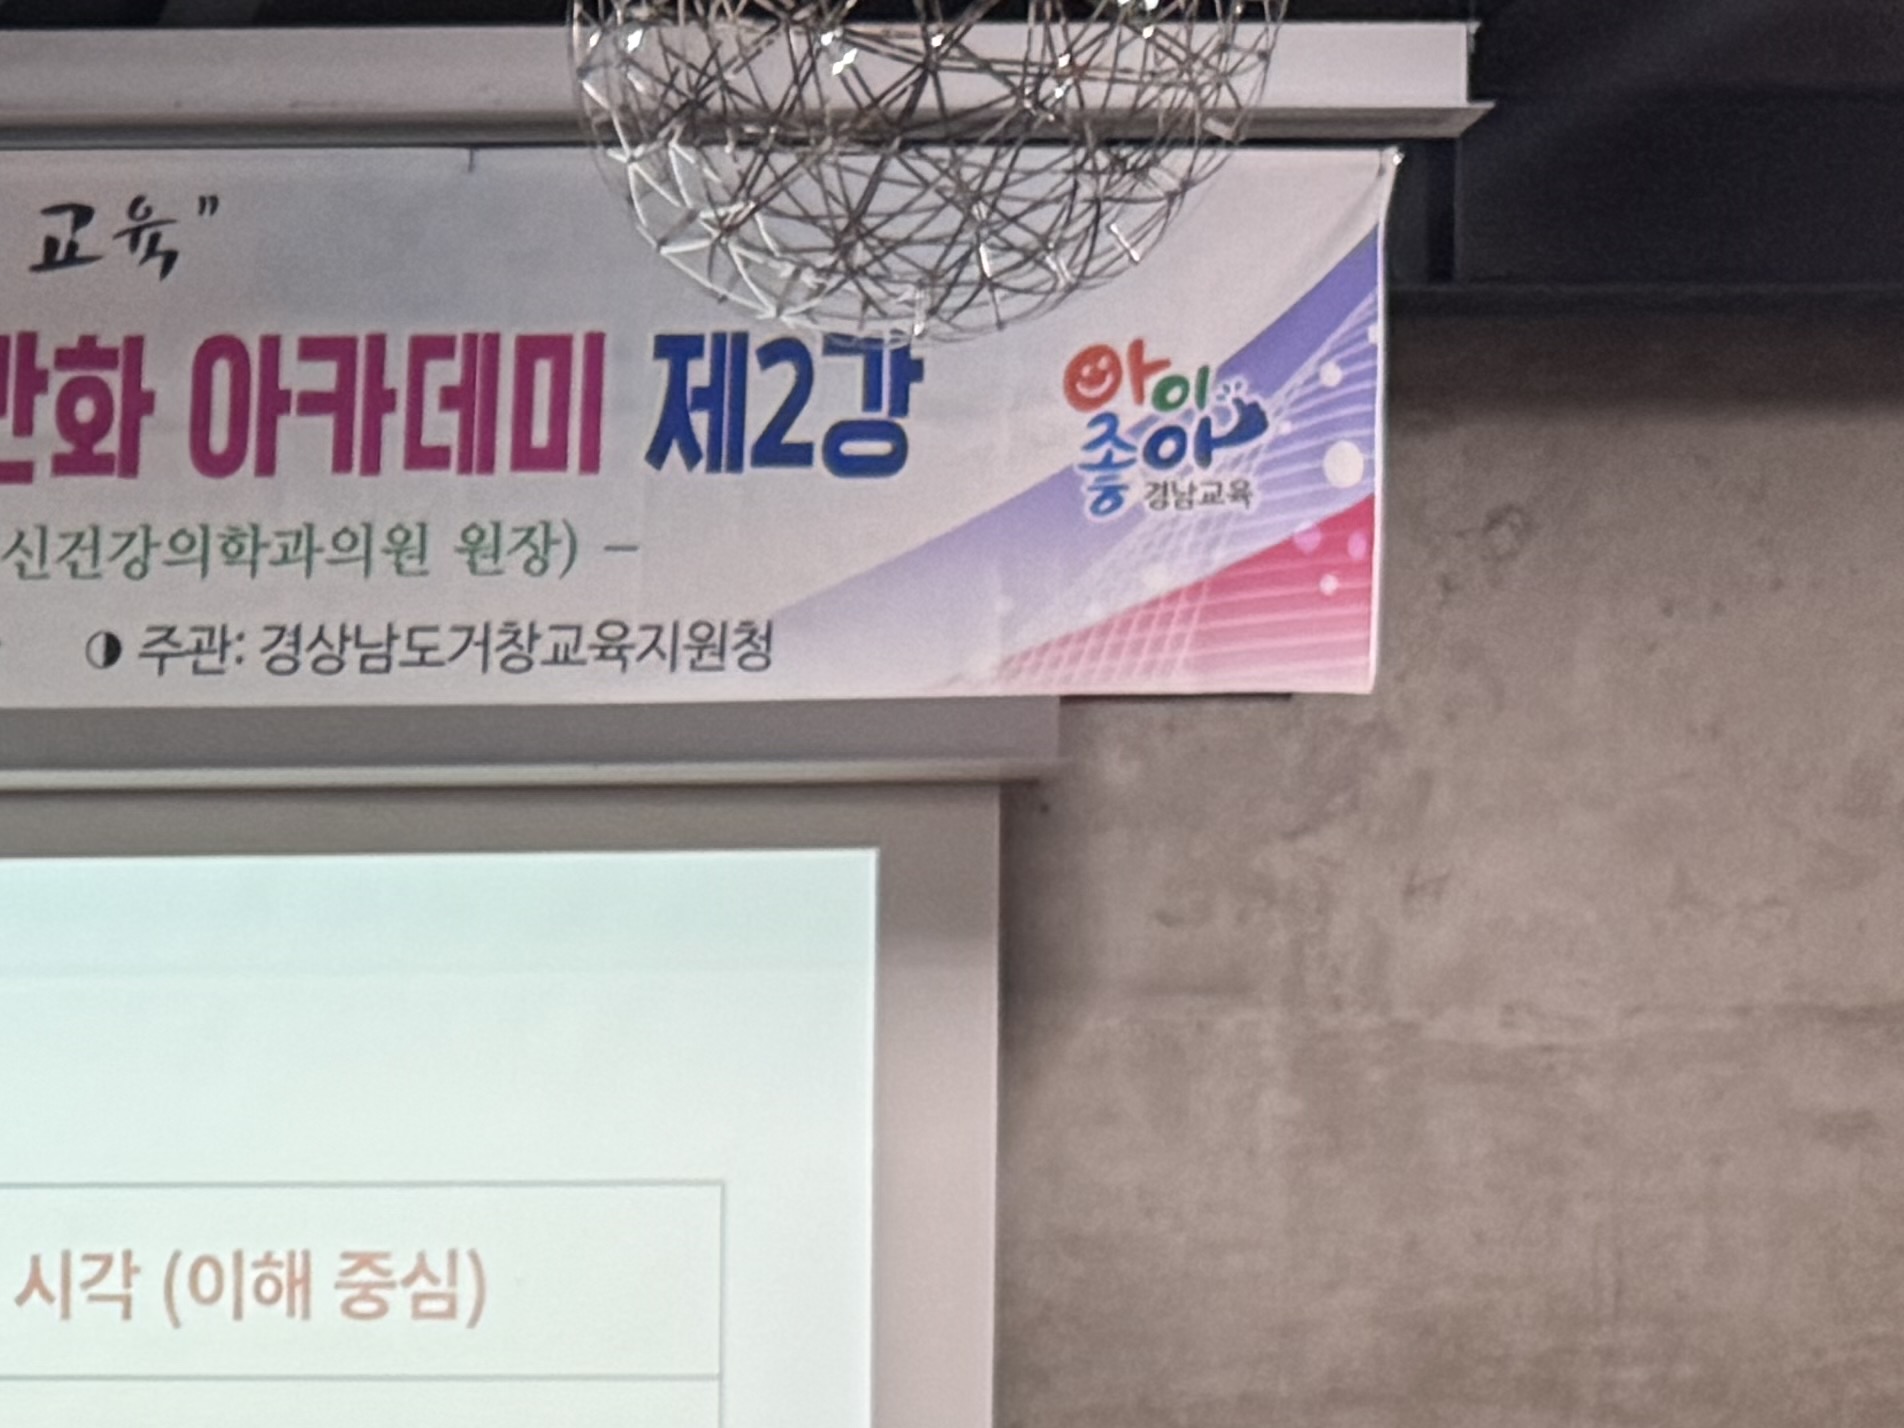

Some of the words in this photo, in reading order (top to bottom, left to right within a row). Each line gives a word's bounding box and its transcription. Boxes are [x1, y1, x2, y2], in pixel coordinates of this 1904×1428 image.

[189, 331, 606, 479] 아카데미
[644, 331, 924, 479] 제2강
[1143, 478, 1252, 511] 경남교육
[455, 518, 578, 580] 원장)
[260, 619, 774, 677] 경상남도거창교육지원청
[14, 1248, 141, 1321] 시각
[164, 1248, 312, 1329] (이해
[334, 1248, 486, 1329] 중심)
